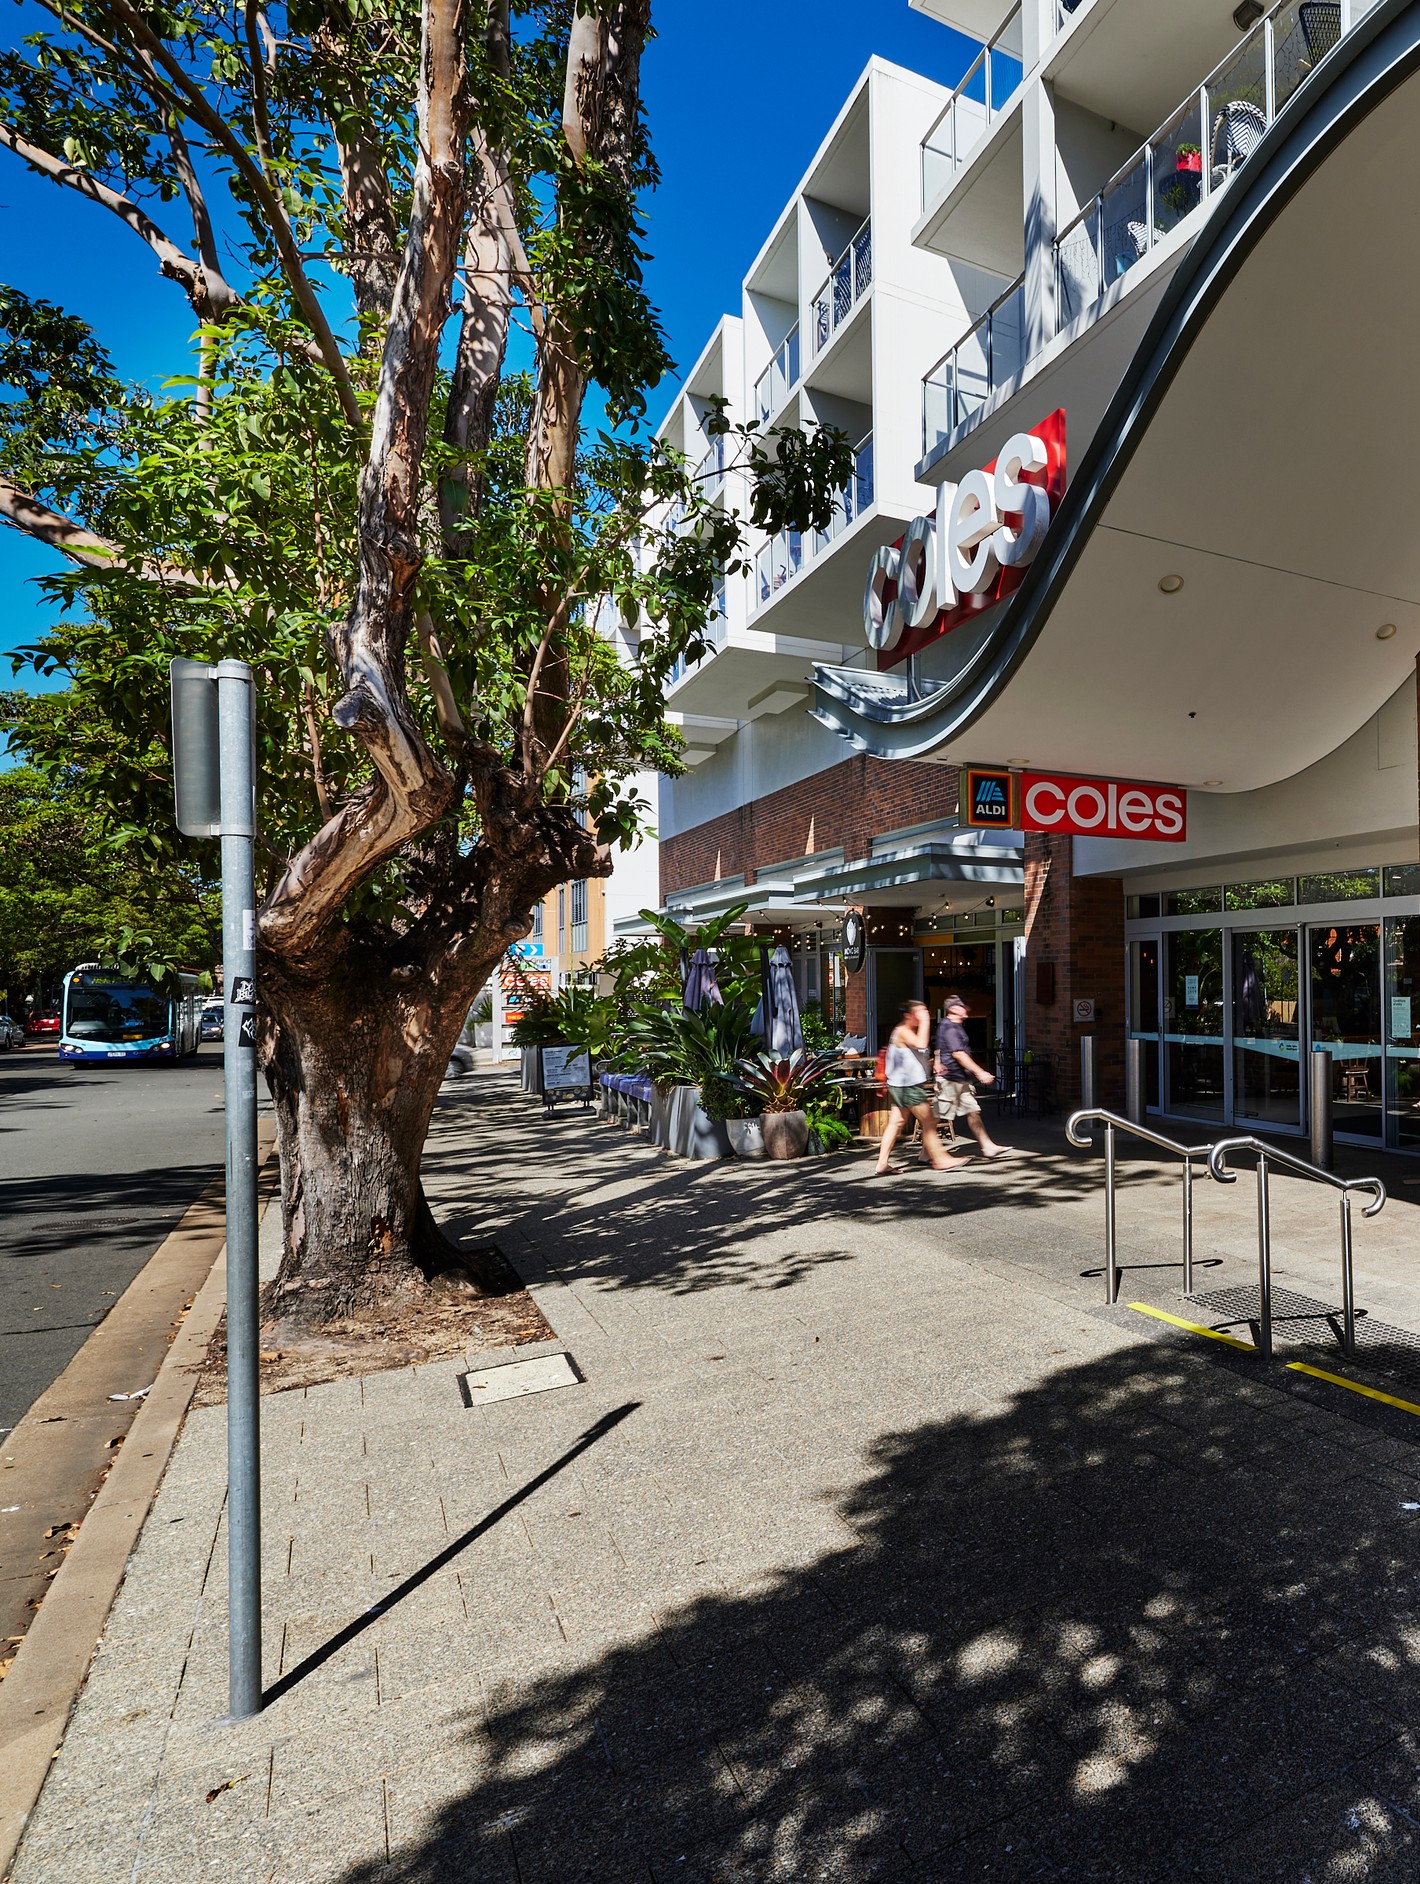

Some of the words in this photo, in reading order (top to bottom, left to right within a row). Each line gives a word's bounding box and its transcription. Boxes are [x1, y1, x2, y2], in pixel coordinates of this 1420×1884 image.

[864, 432, 1050, 651] coles
[976, 803, 1006, 816] ALDI
[1025, 781, 1183, 835] coles
